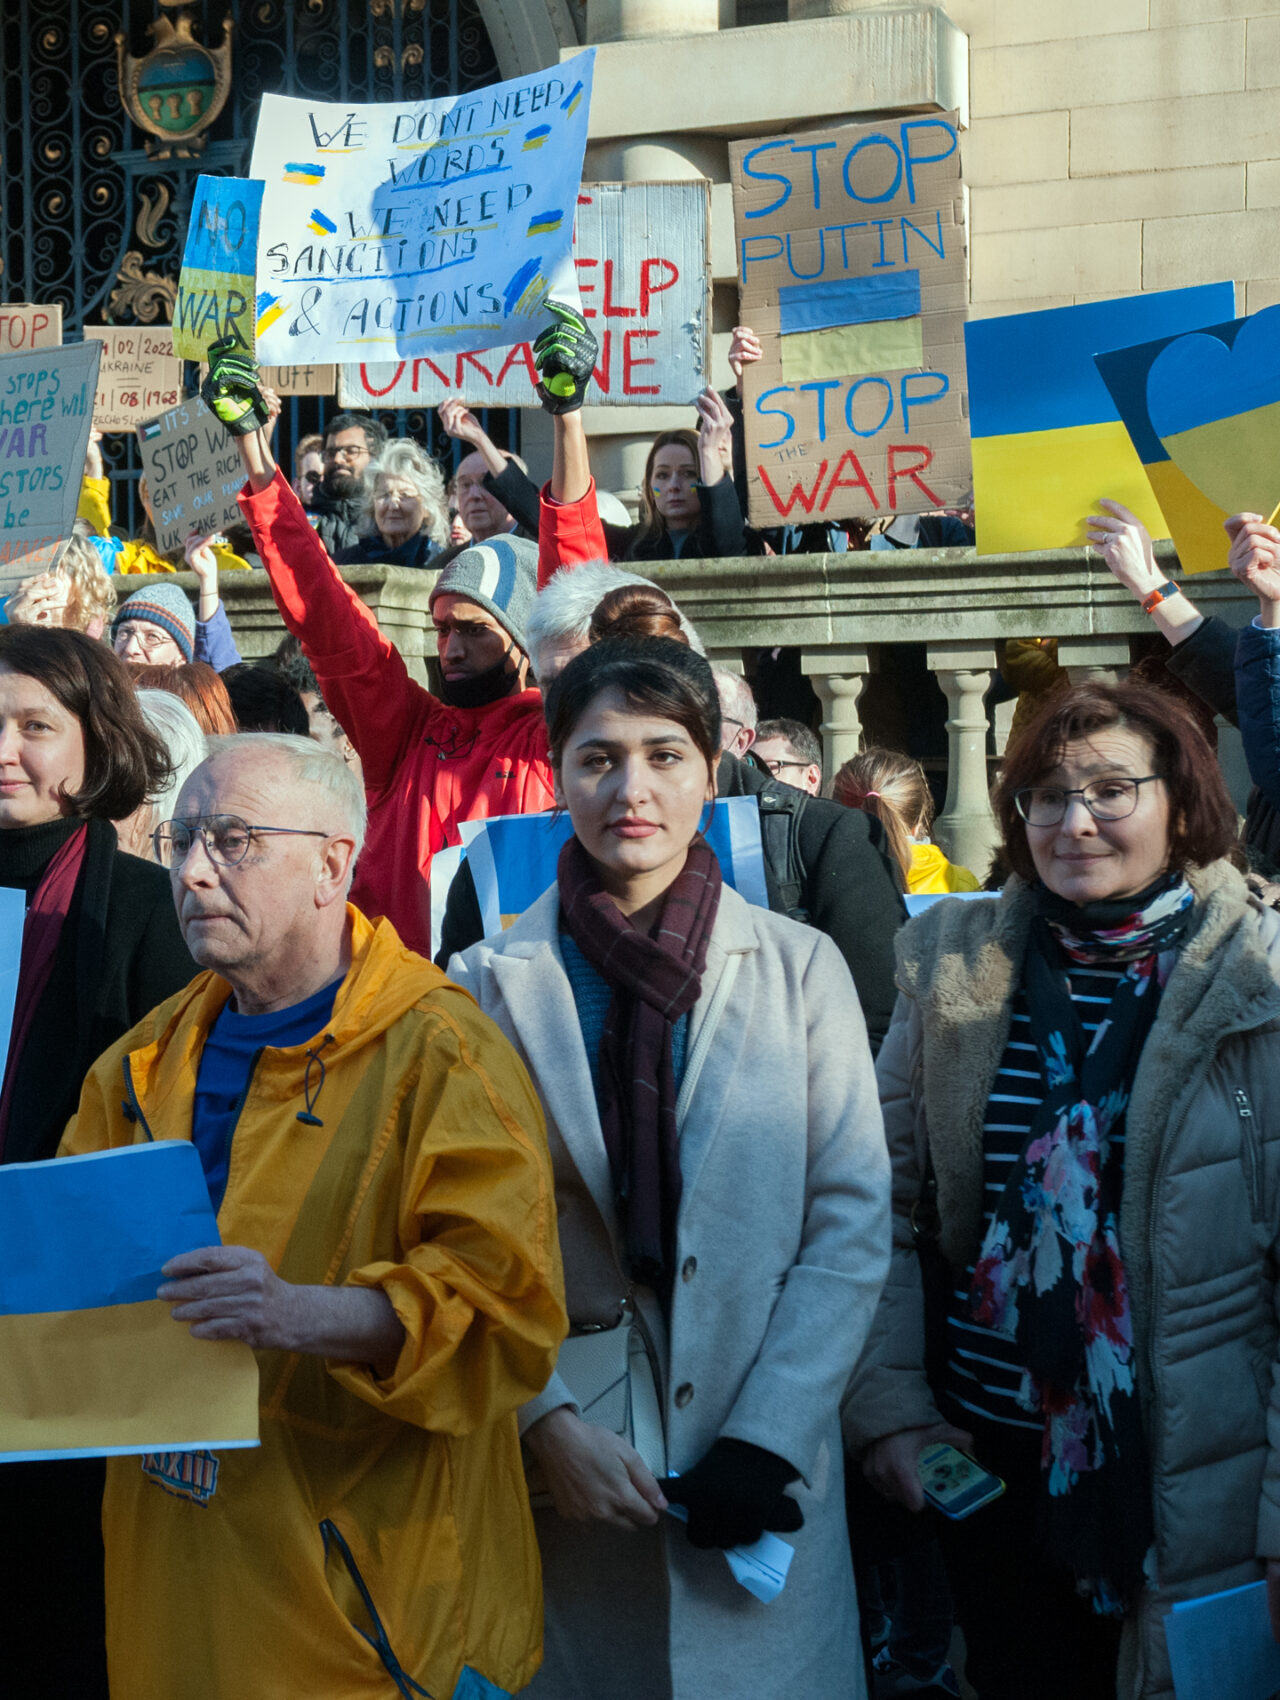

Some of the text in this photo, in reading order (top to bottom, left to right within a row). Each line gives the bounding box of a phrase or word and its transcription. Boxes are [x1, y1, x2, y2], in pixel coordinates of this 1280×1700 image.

[308, 112, 368, 147] WE
[486, 79, 565, 128] NEED
[382, 137, 505, 186] WORDS
[742, 118, 958, 219] STOP
[195, 200, 247, 252] NO
[344, 206, 411, 239] WE
[426, 183, 532, 231] NEED
[741, 210, 946, 283] PUTIN
[179, 286, 250, 350] WAR
[288, 285, 322, 336] &
[61, 383, 88, 417] will
[164, 408, 189, 431] IT'S
[755, 371, 950, 448] STOP
[151, 433, 198, 483] STOP
[775, 444, 808, 463] THE
[153, 452, 241, 508] EAT THE RICH
[757, 444, 946, 518] WAR
[4, 501, 30, 529] be
[162, 528, 182, 550] UK
